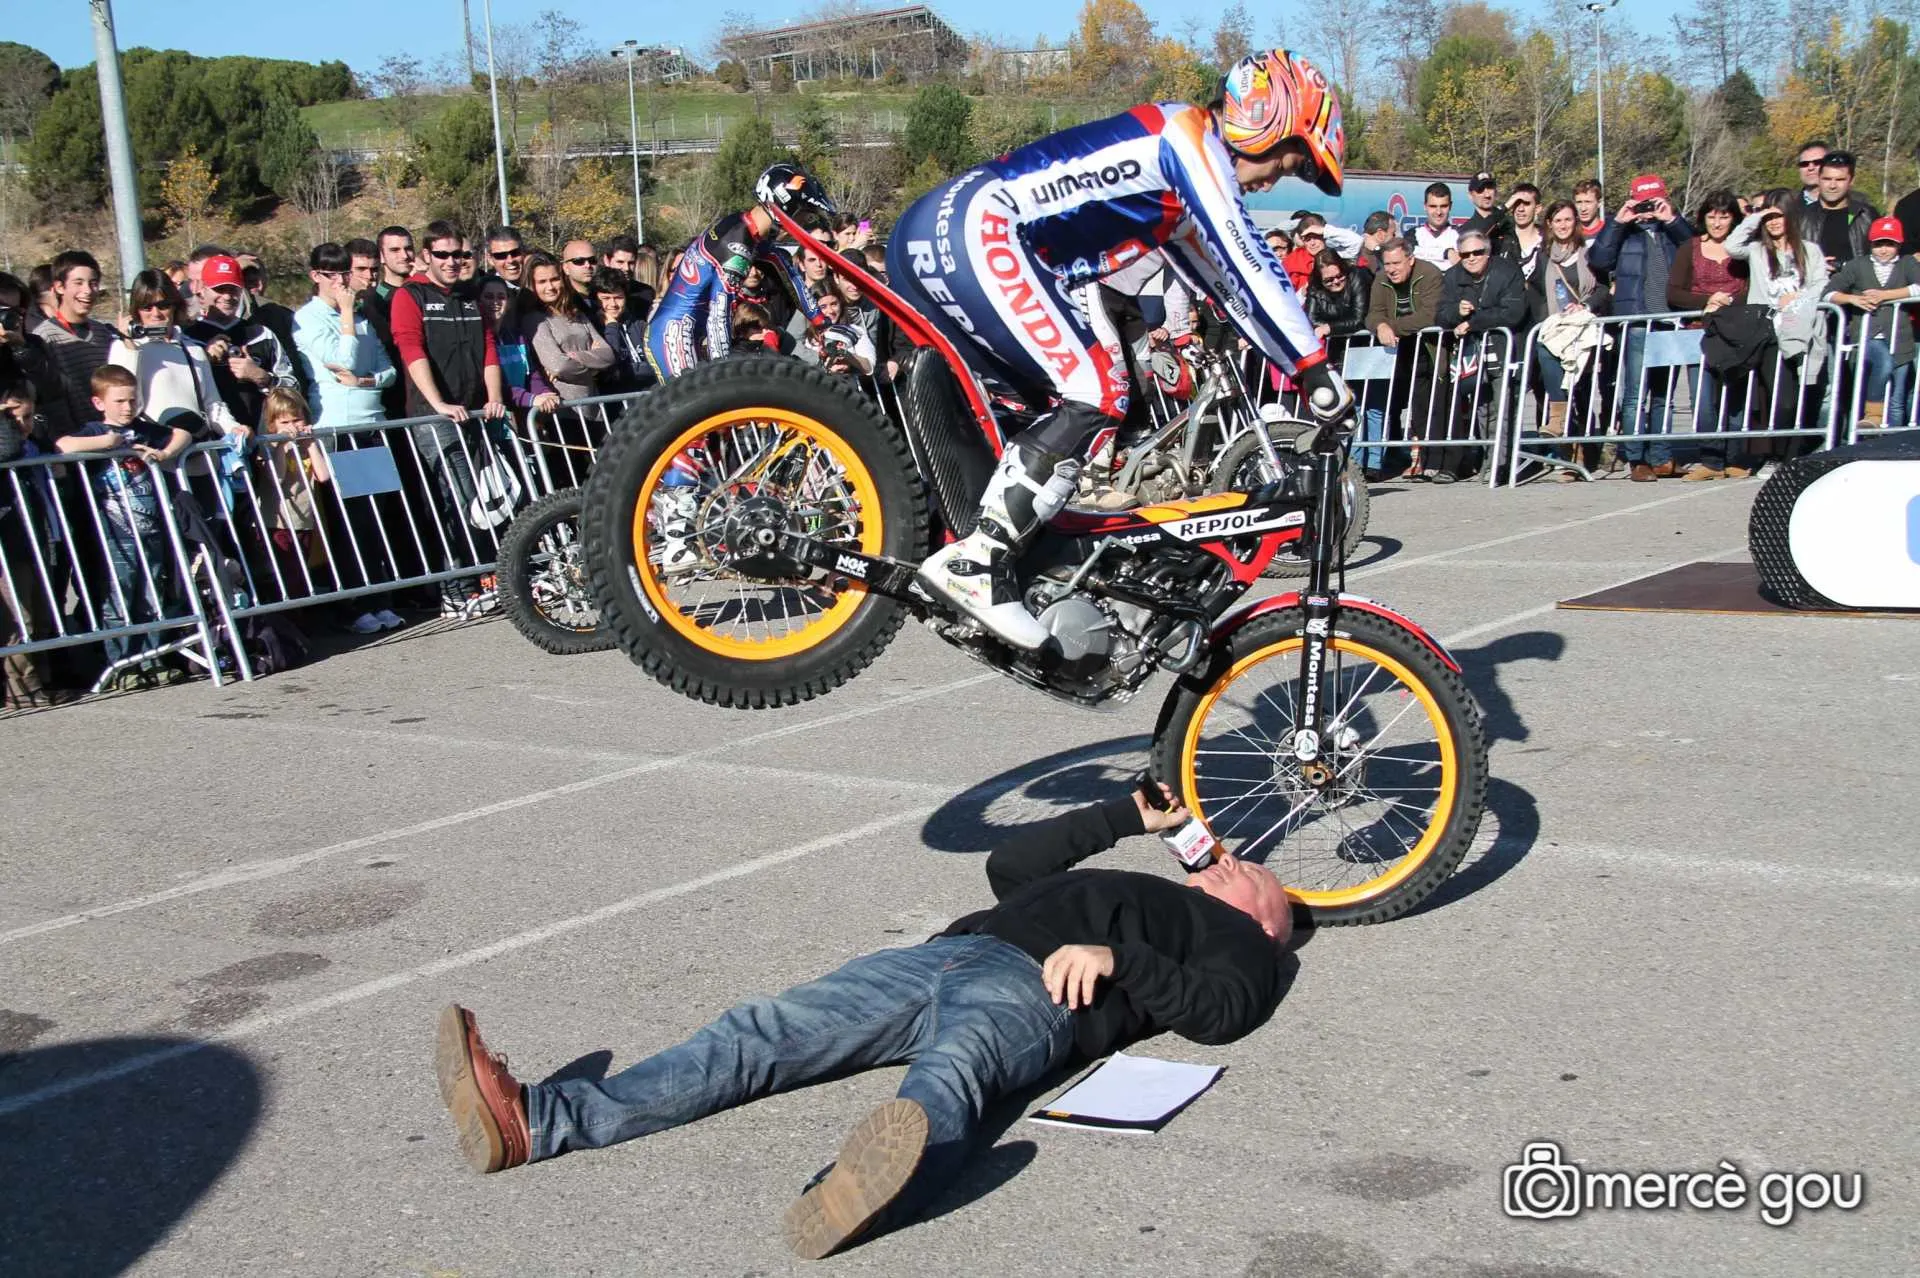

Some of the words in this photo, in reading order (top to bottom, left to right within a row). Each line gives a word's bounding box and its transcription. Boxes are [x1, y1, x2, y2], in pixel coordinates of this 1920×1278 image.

[1030, 159, 1141, 205] GOLDWIN
[1225, 219, 1262, 274] GOLDWIN
[980, 209, 1081, 383] HONDA
[1214, 281, 1249, 320] GOLDWIN
[1093, 532, 1162, 550] Mtesa
[1180, 514, 1254, 537] REPSOL
[835, 553, 870, 574] NGK
[1304, 641, 1323, 727] Montesa
